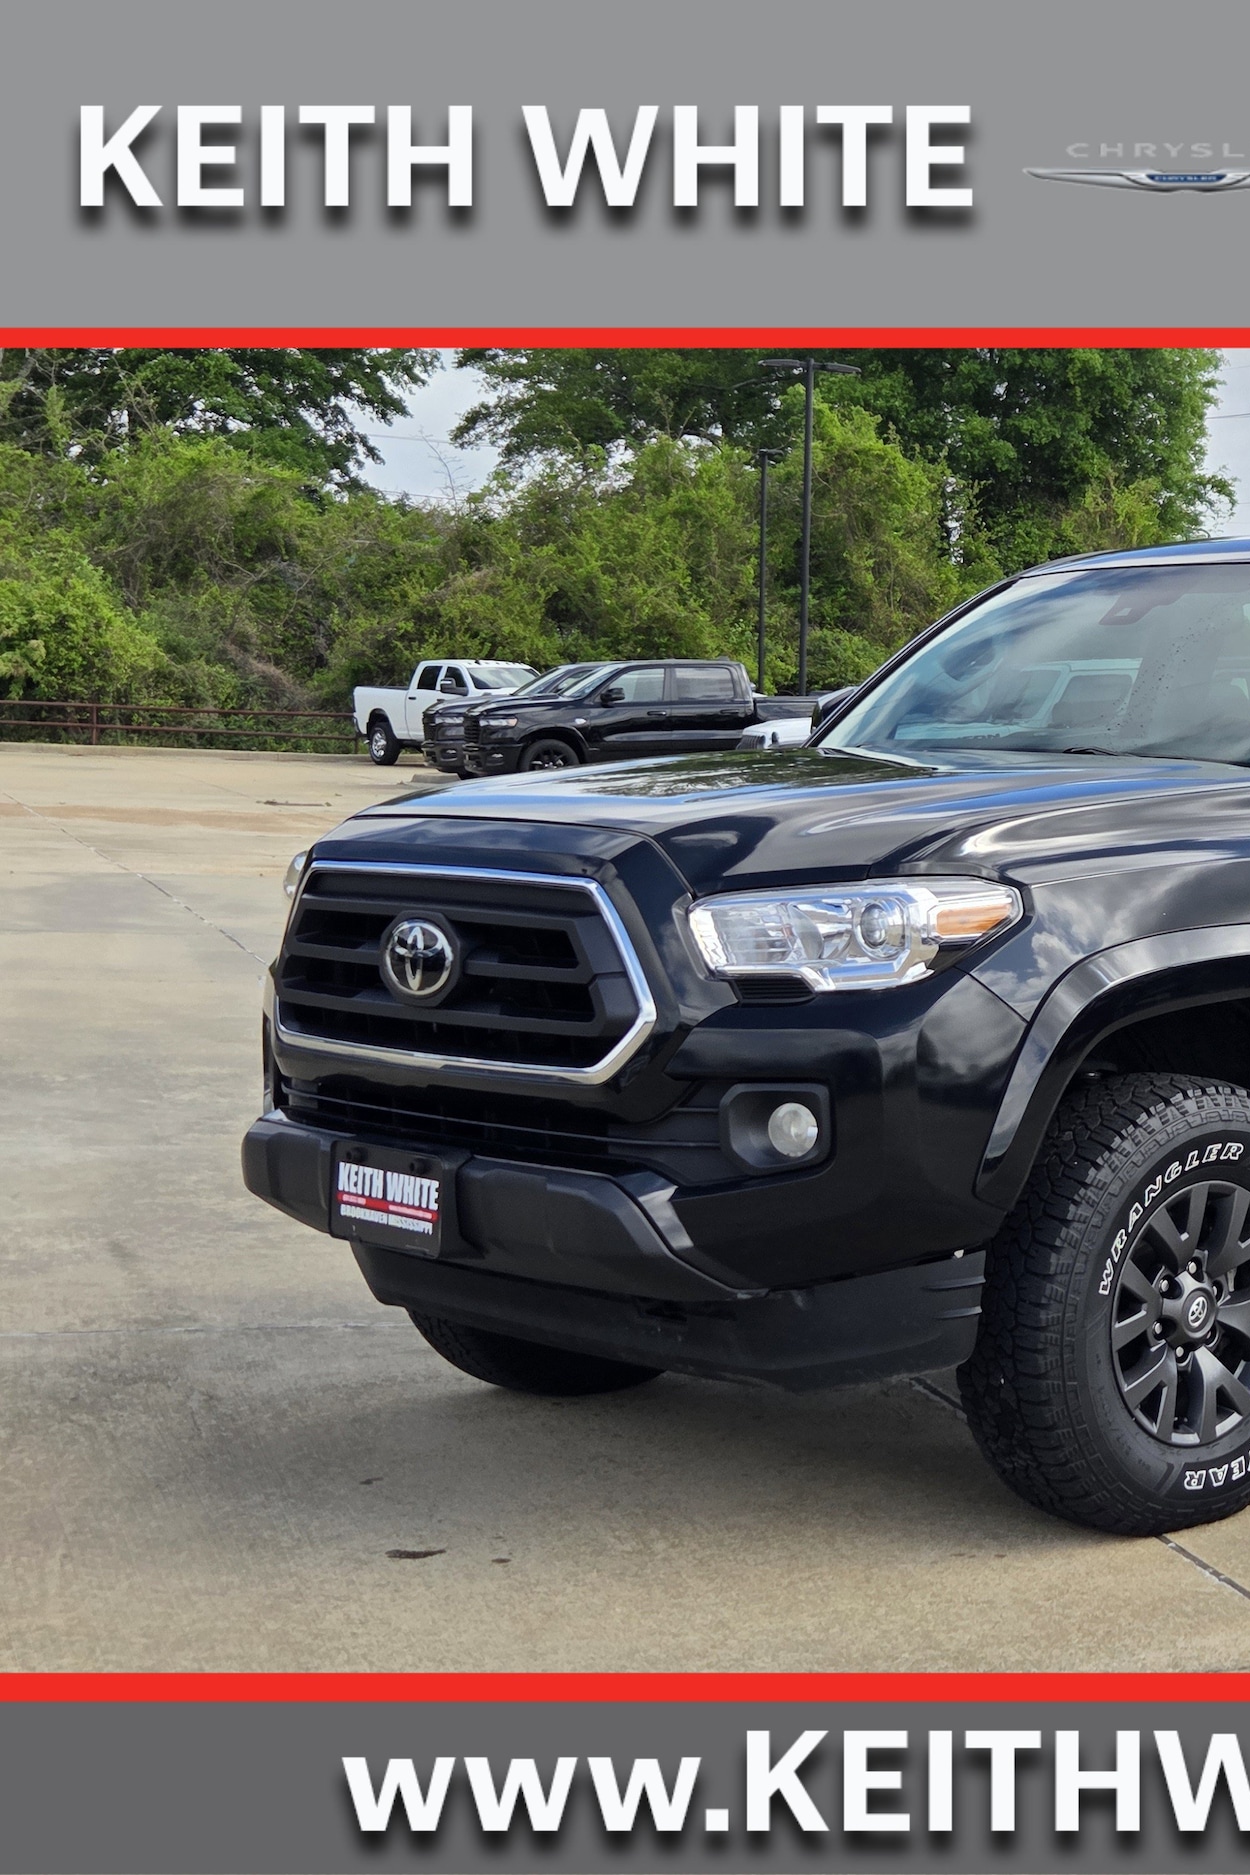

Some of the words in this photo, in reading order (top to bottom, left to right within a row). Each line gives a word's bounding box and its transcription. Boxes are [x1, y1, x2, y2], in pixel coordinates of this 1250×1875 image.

[337, 1160, 385, 1200] KEITH
[385, 1170, 441, 1212] WHITE
[1098, 1141, 1245, 1296] WRANGLER
